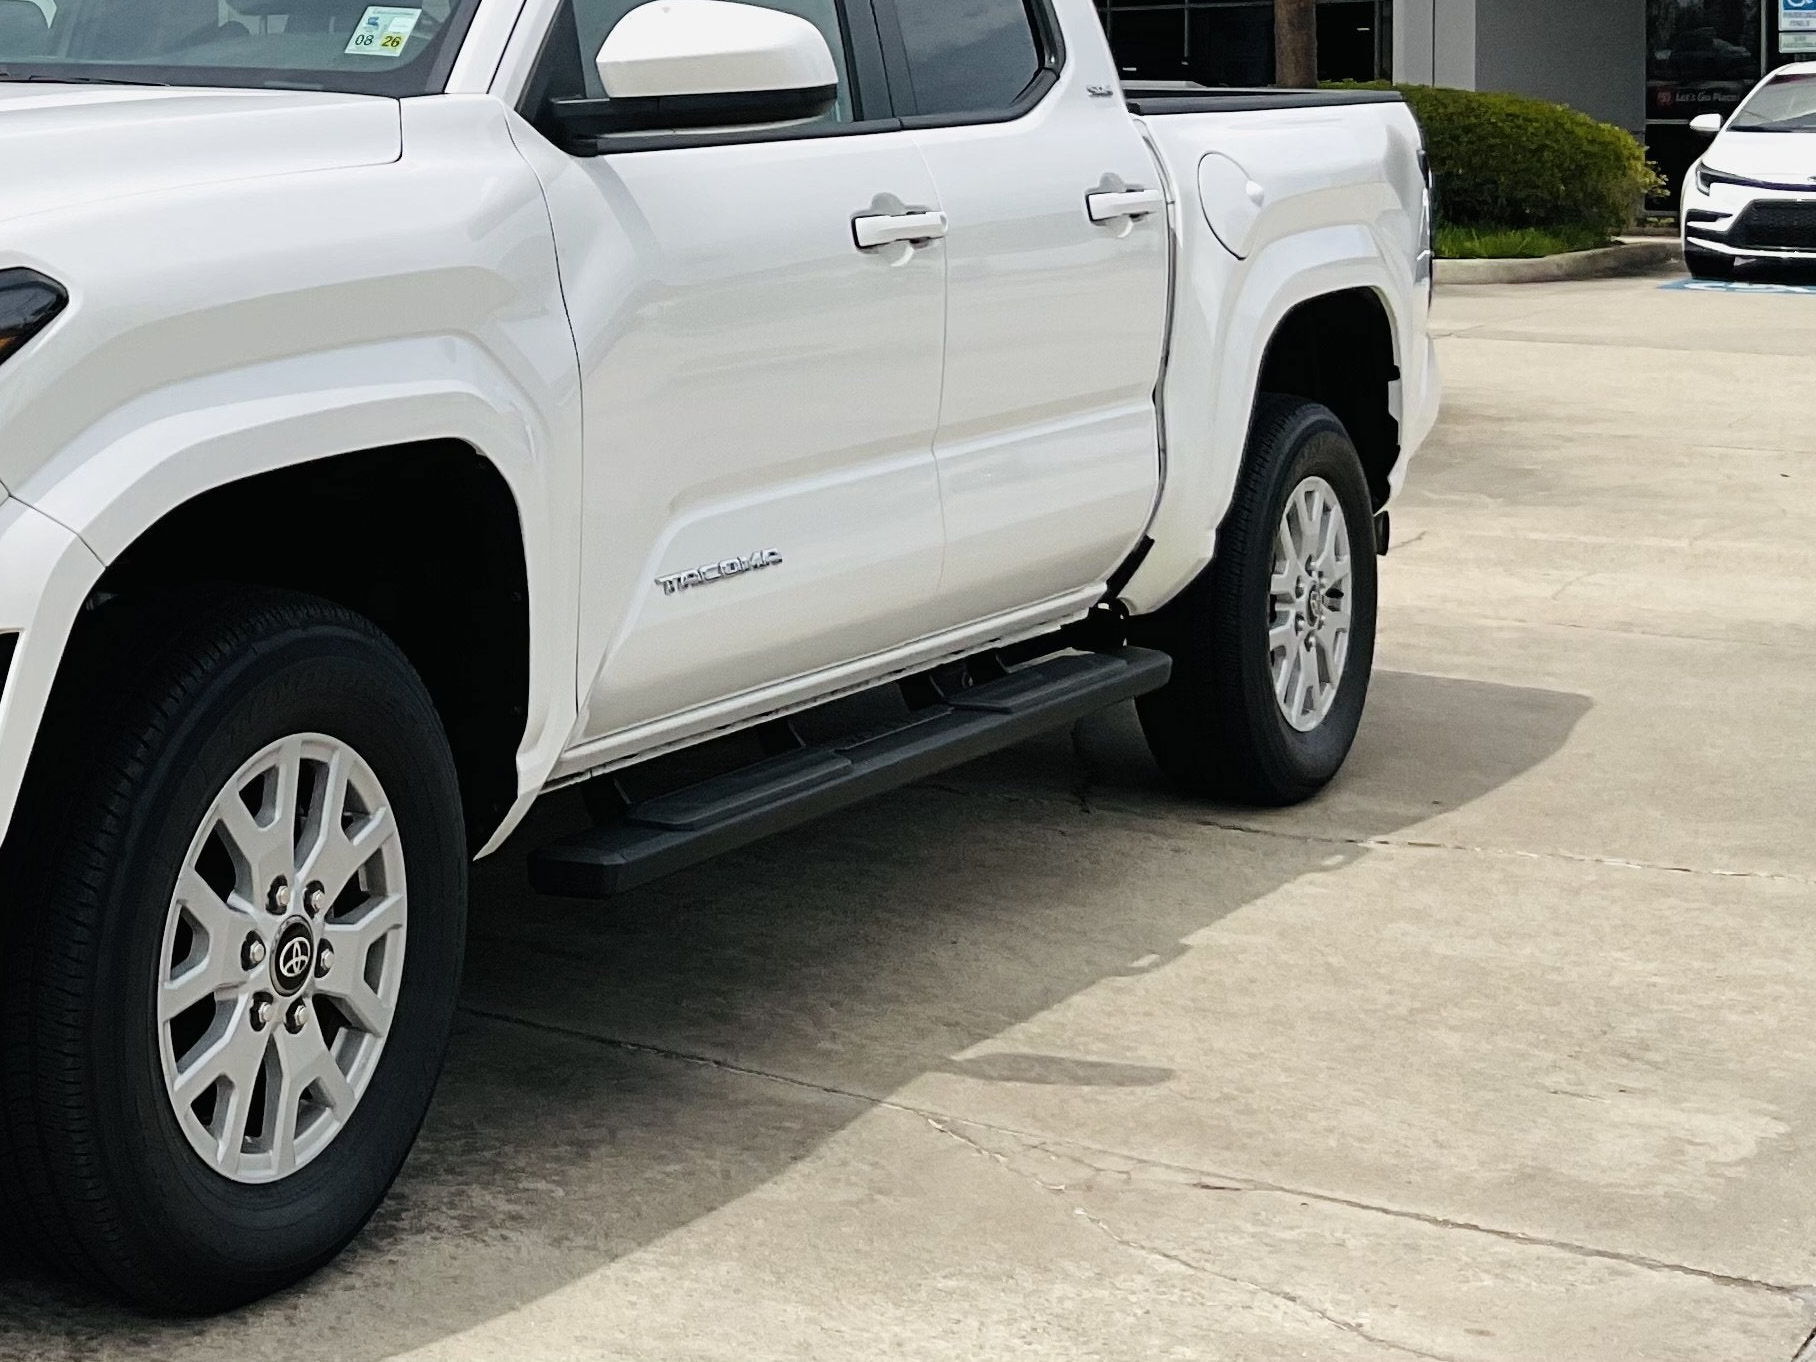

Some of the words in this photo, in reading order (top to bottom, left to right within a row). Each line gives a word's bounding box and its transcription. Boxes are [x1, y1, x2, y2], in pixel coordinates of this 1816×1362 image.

[355, 34, 374, 46] 08
[381, 35, 402, 48] 26
[654, 547, 783, 596] TACOMA
